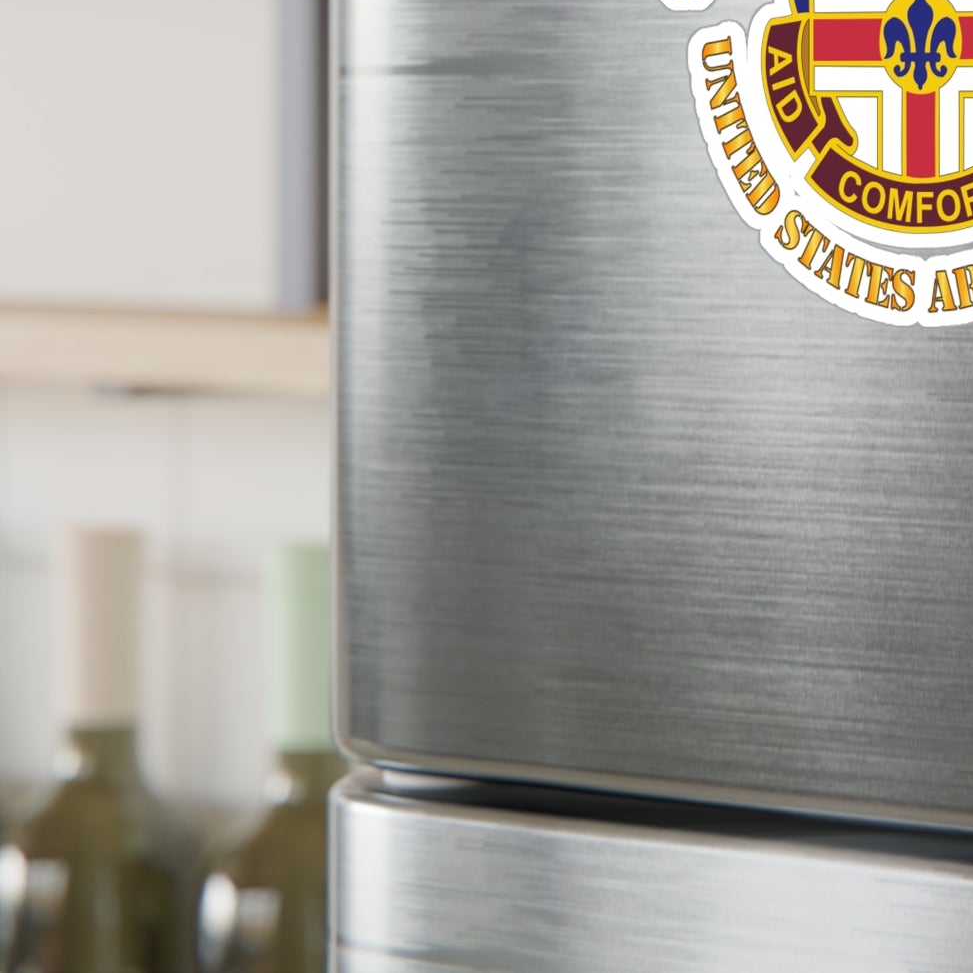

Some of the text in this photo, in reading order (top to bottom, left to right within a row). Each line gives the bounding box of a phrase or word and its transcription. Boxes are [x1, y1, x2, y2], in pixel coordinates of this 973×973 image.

[768, 46, 802, 123] AID
[702, 35, 781, 216] UNITED
[774, 209, 916, 312] STATES
